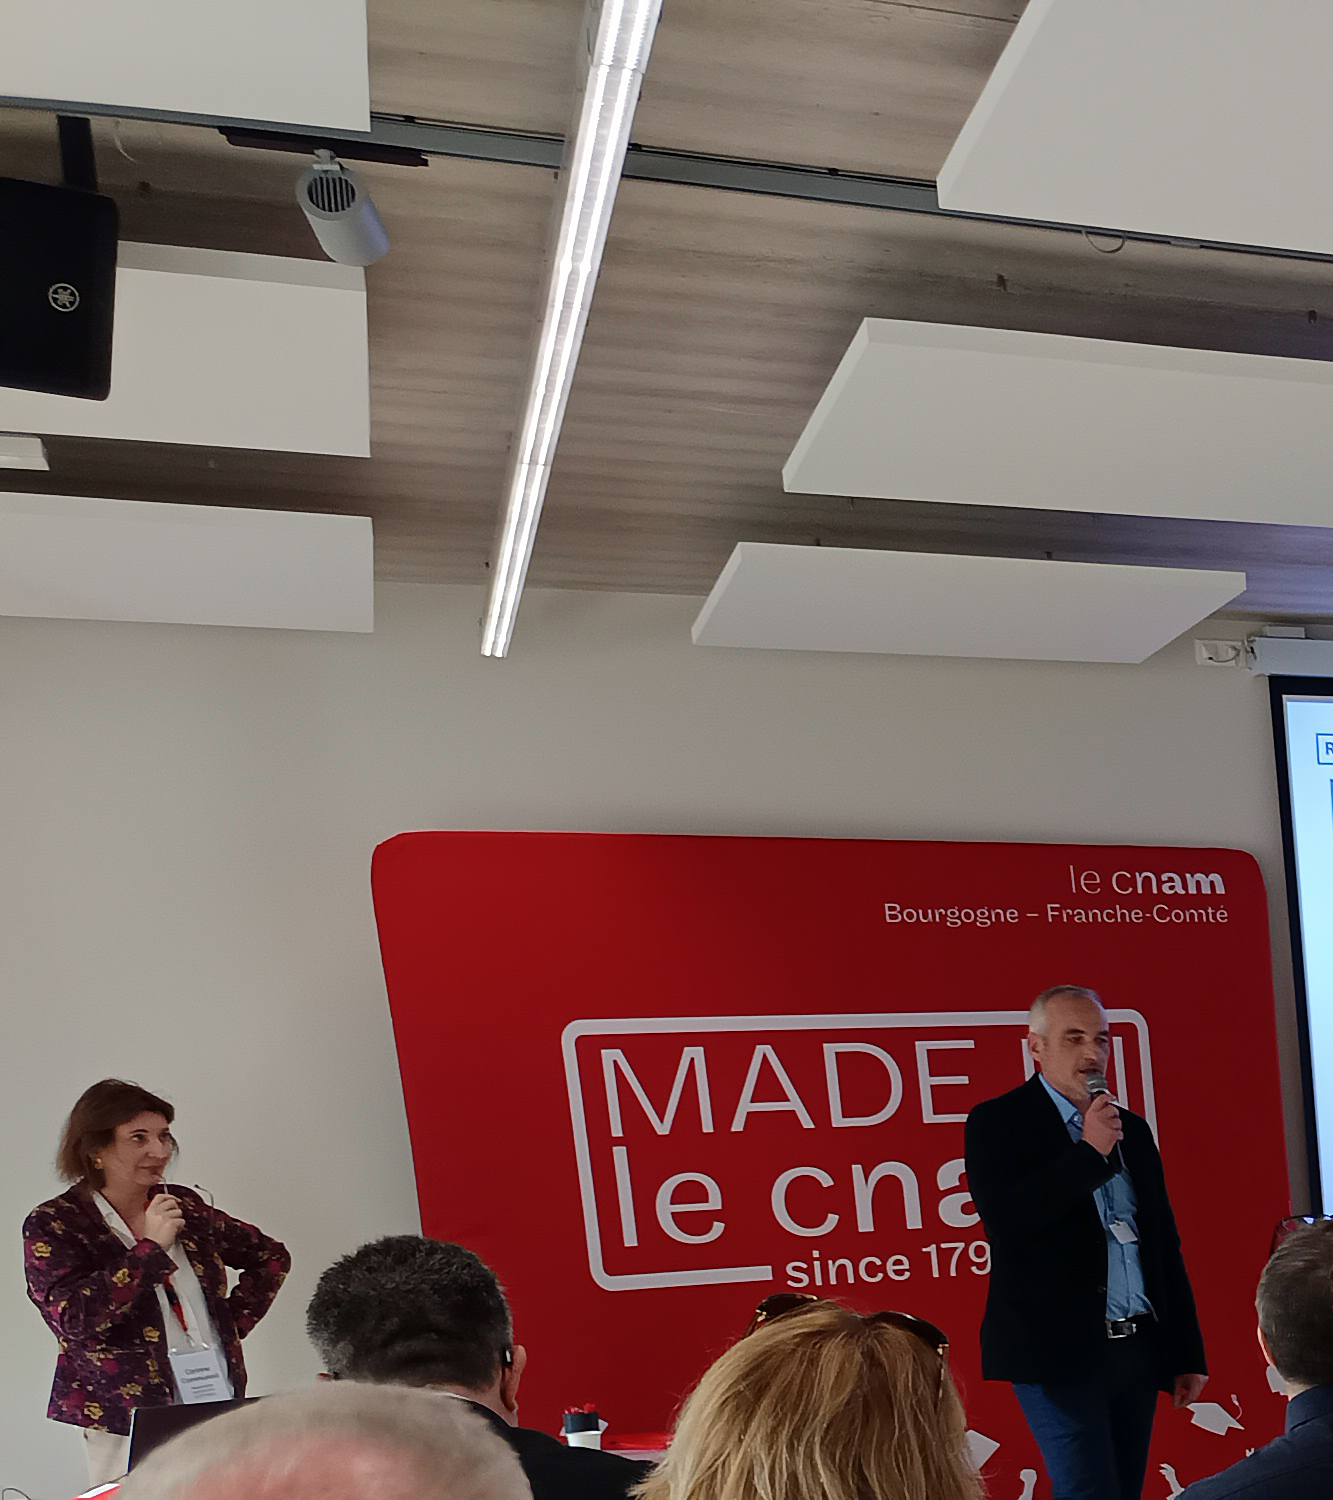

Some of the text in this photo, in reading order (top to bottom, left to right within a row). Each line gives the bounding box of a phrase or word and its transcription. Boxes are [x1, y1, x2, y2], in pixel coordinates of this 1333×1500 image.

[1068, 864, 1226, 895] le cnam
[884, 903, 1020, 927] Bourgogne
[1046, 903, 1229, 924] Franche-Comté
[600, 1039, 975, 1138] MADE
[611, 1146, 982, 1247] le cna
[785, 1240, 992, 1288] since 179
